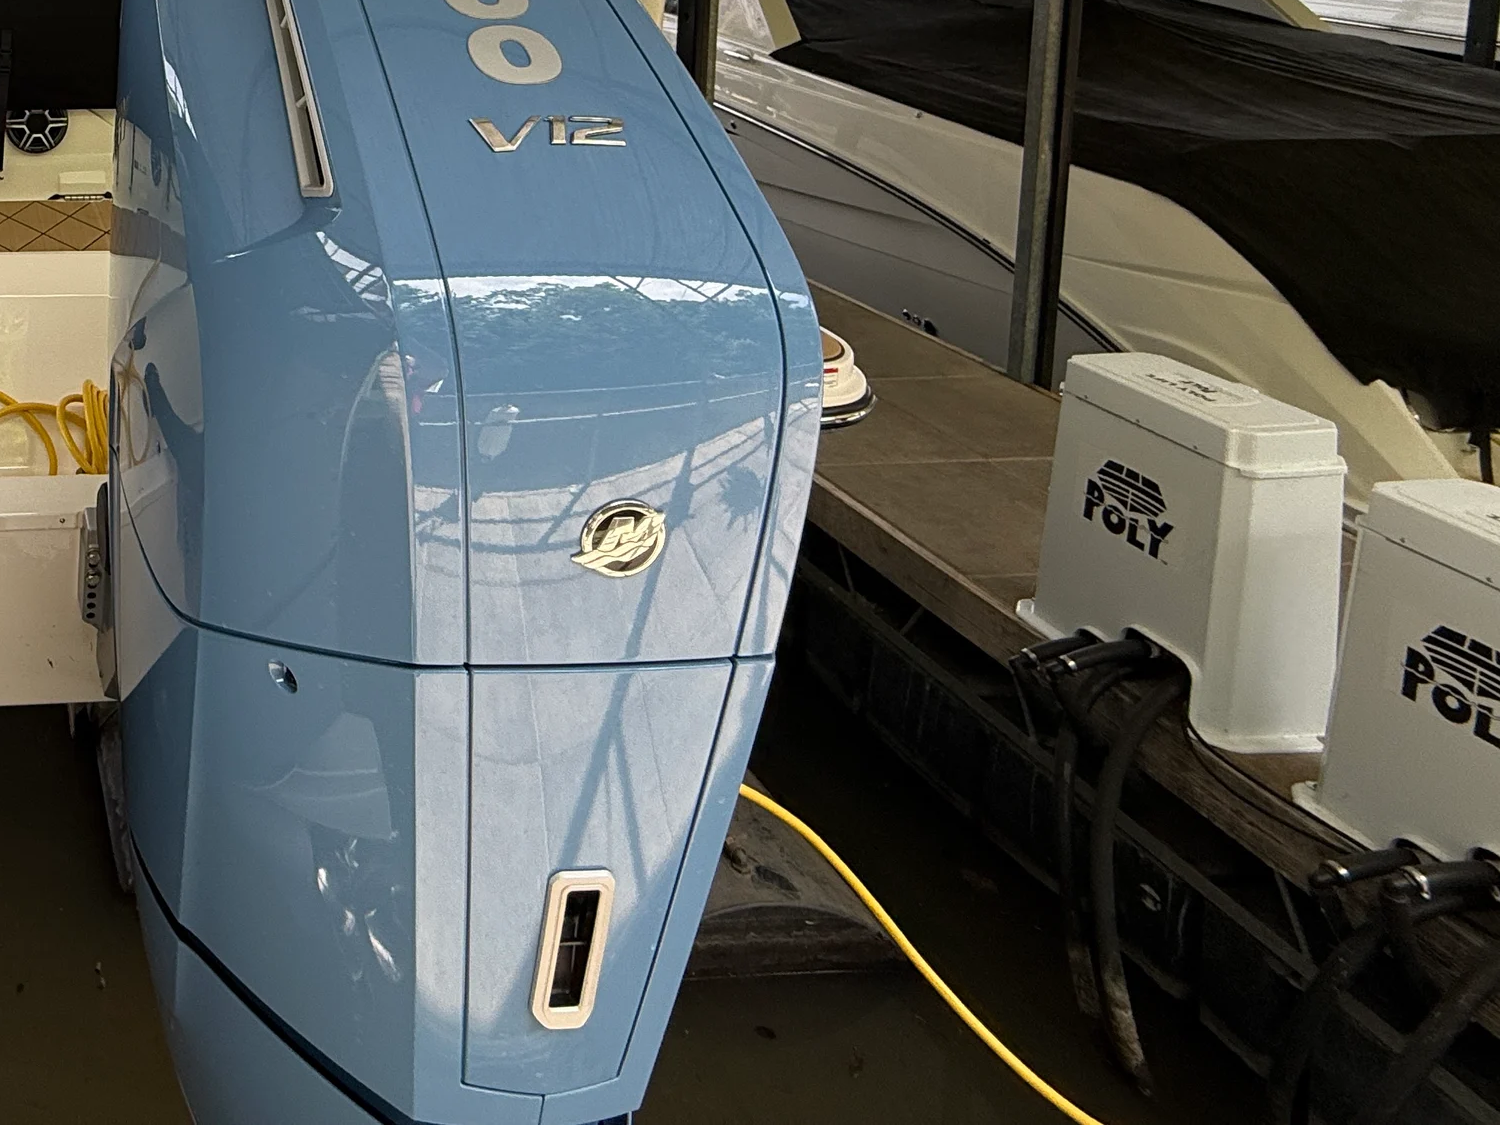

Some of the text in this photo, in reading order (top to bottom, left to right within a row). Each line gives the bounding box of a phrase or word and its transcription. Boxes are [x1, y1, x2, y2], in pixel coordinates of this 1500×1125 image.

[469, 115, 627, 153] V12
[1083, 478, 1174, 560] POLY
[1401, 646, 1500, 750] POL
